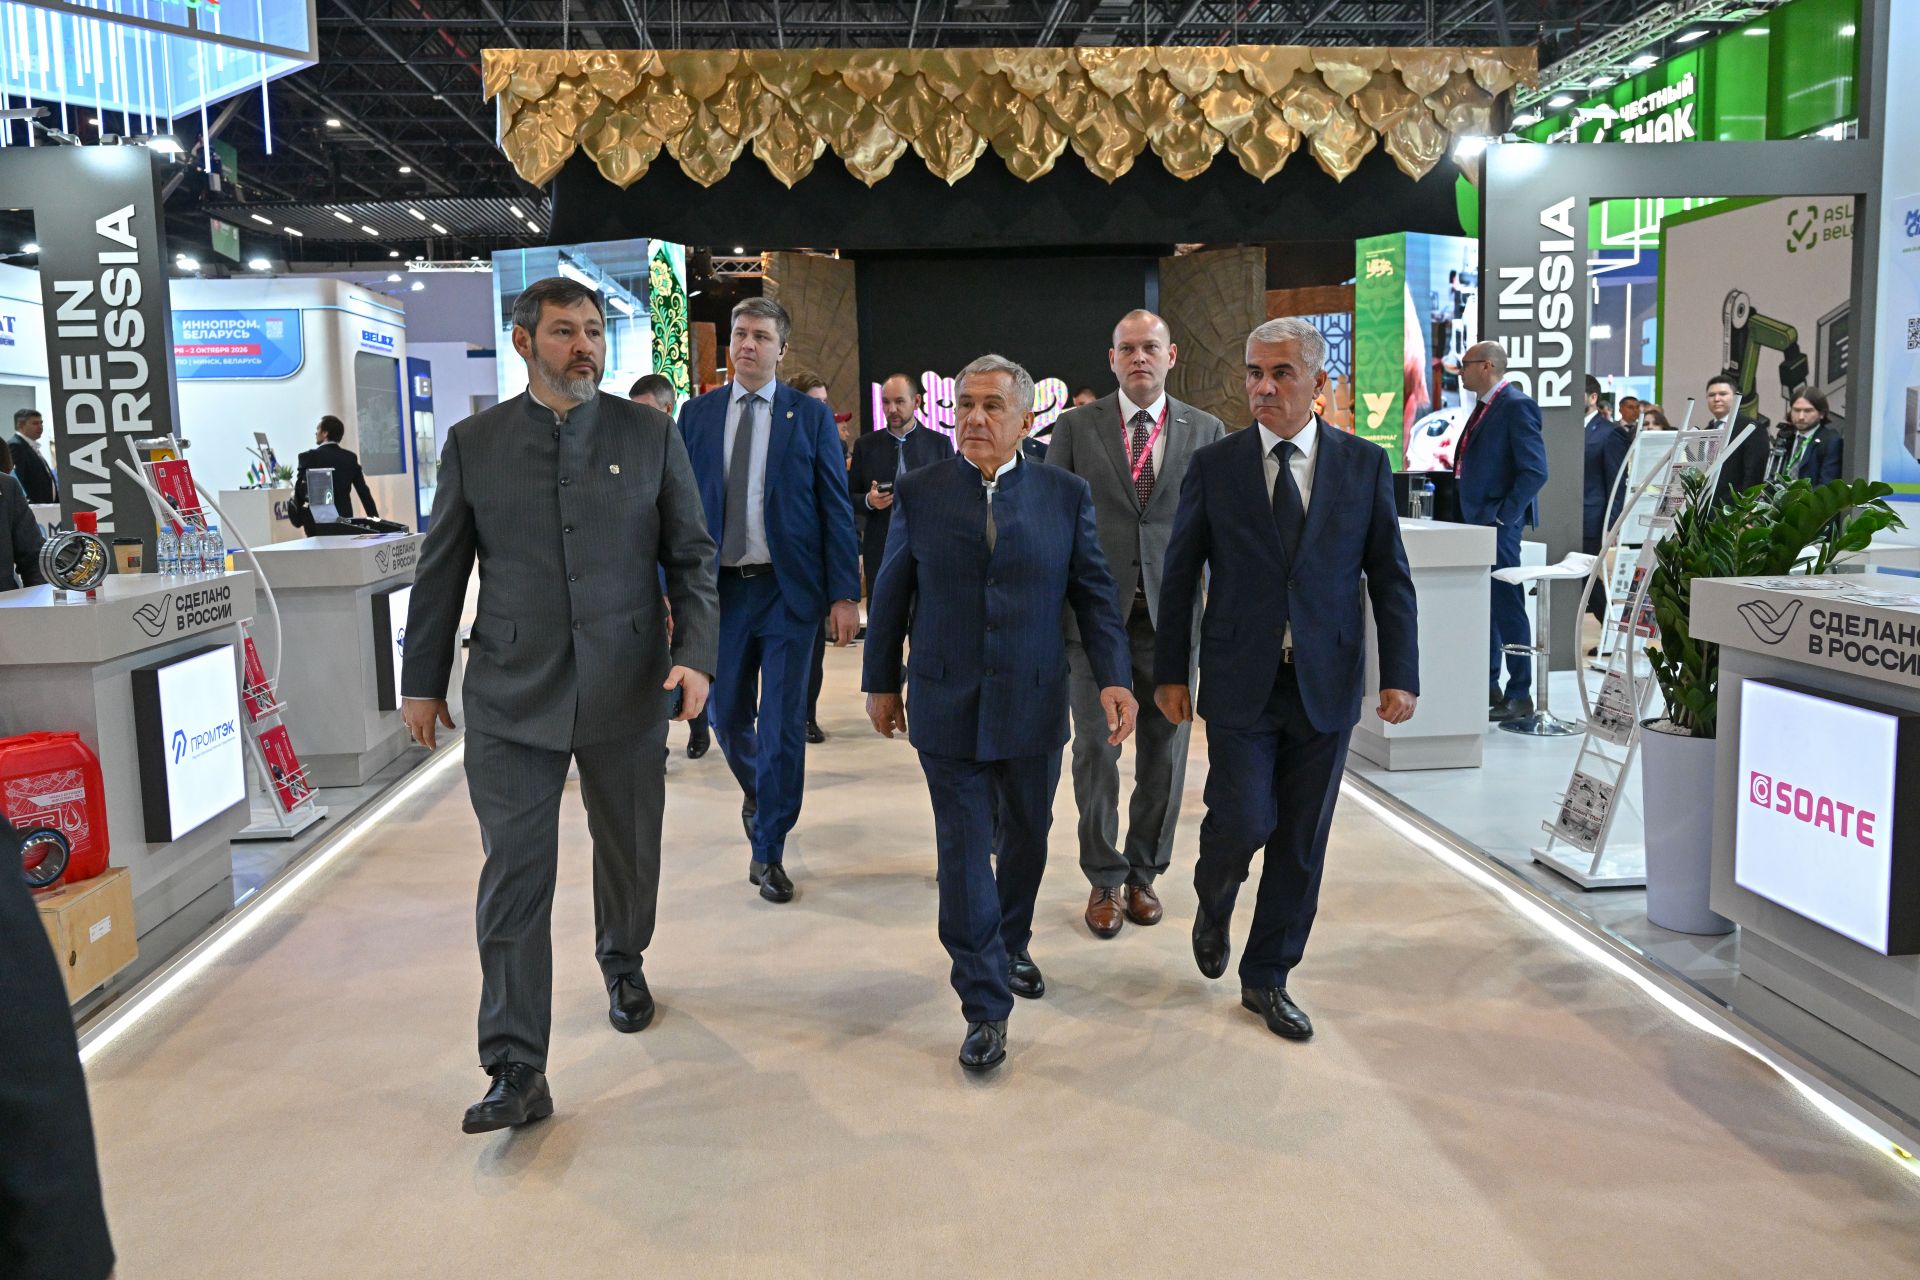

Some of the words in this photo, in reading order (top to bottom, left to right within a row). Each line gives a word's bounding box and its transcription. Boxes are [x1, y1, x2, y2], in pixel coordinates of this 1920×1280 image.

[1619, 72, 1695, 122] ЧЕСТНЫЙ
[1620, 102, 1696, 144] ЗНАК
[1824, 204, 1854, 223] ASL
[53, 280, 98, 338] IN
[1499, 266, 1534, 320] IN
[1537, 196, 1575, 408] RUSSIA
[95, 203, 153, 433] RUSSIA
[182, 319, 260, 330] ИННОПРОМ.
[183, 329, 251, 340] БЕЛАРУСЬ
[195, 346, 230, 354] ОКТЯБРЯ
[61, 354, 116, 534] MADE
[391, 541, 416, 558] СДЕЛАНО
[397, 554, 416, 568] РОССИИ
[175, 585, 231, 612] СДЕЛАНО
[176, 615, 185, 631] В
[187, 602, 232, 628] РОССИИ
[1808, 633, 1823, 655] В
[1828, 637, 1920, 677] РОССИ
[190, 719, 235, 753] ПРОМТЭК
[1775, 781, 1876, 848] SOATE
